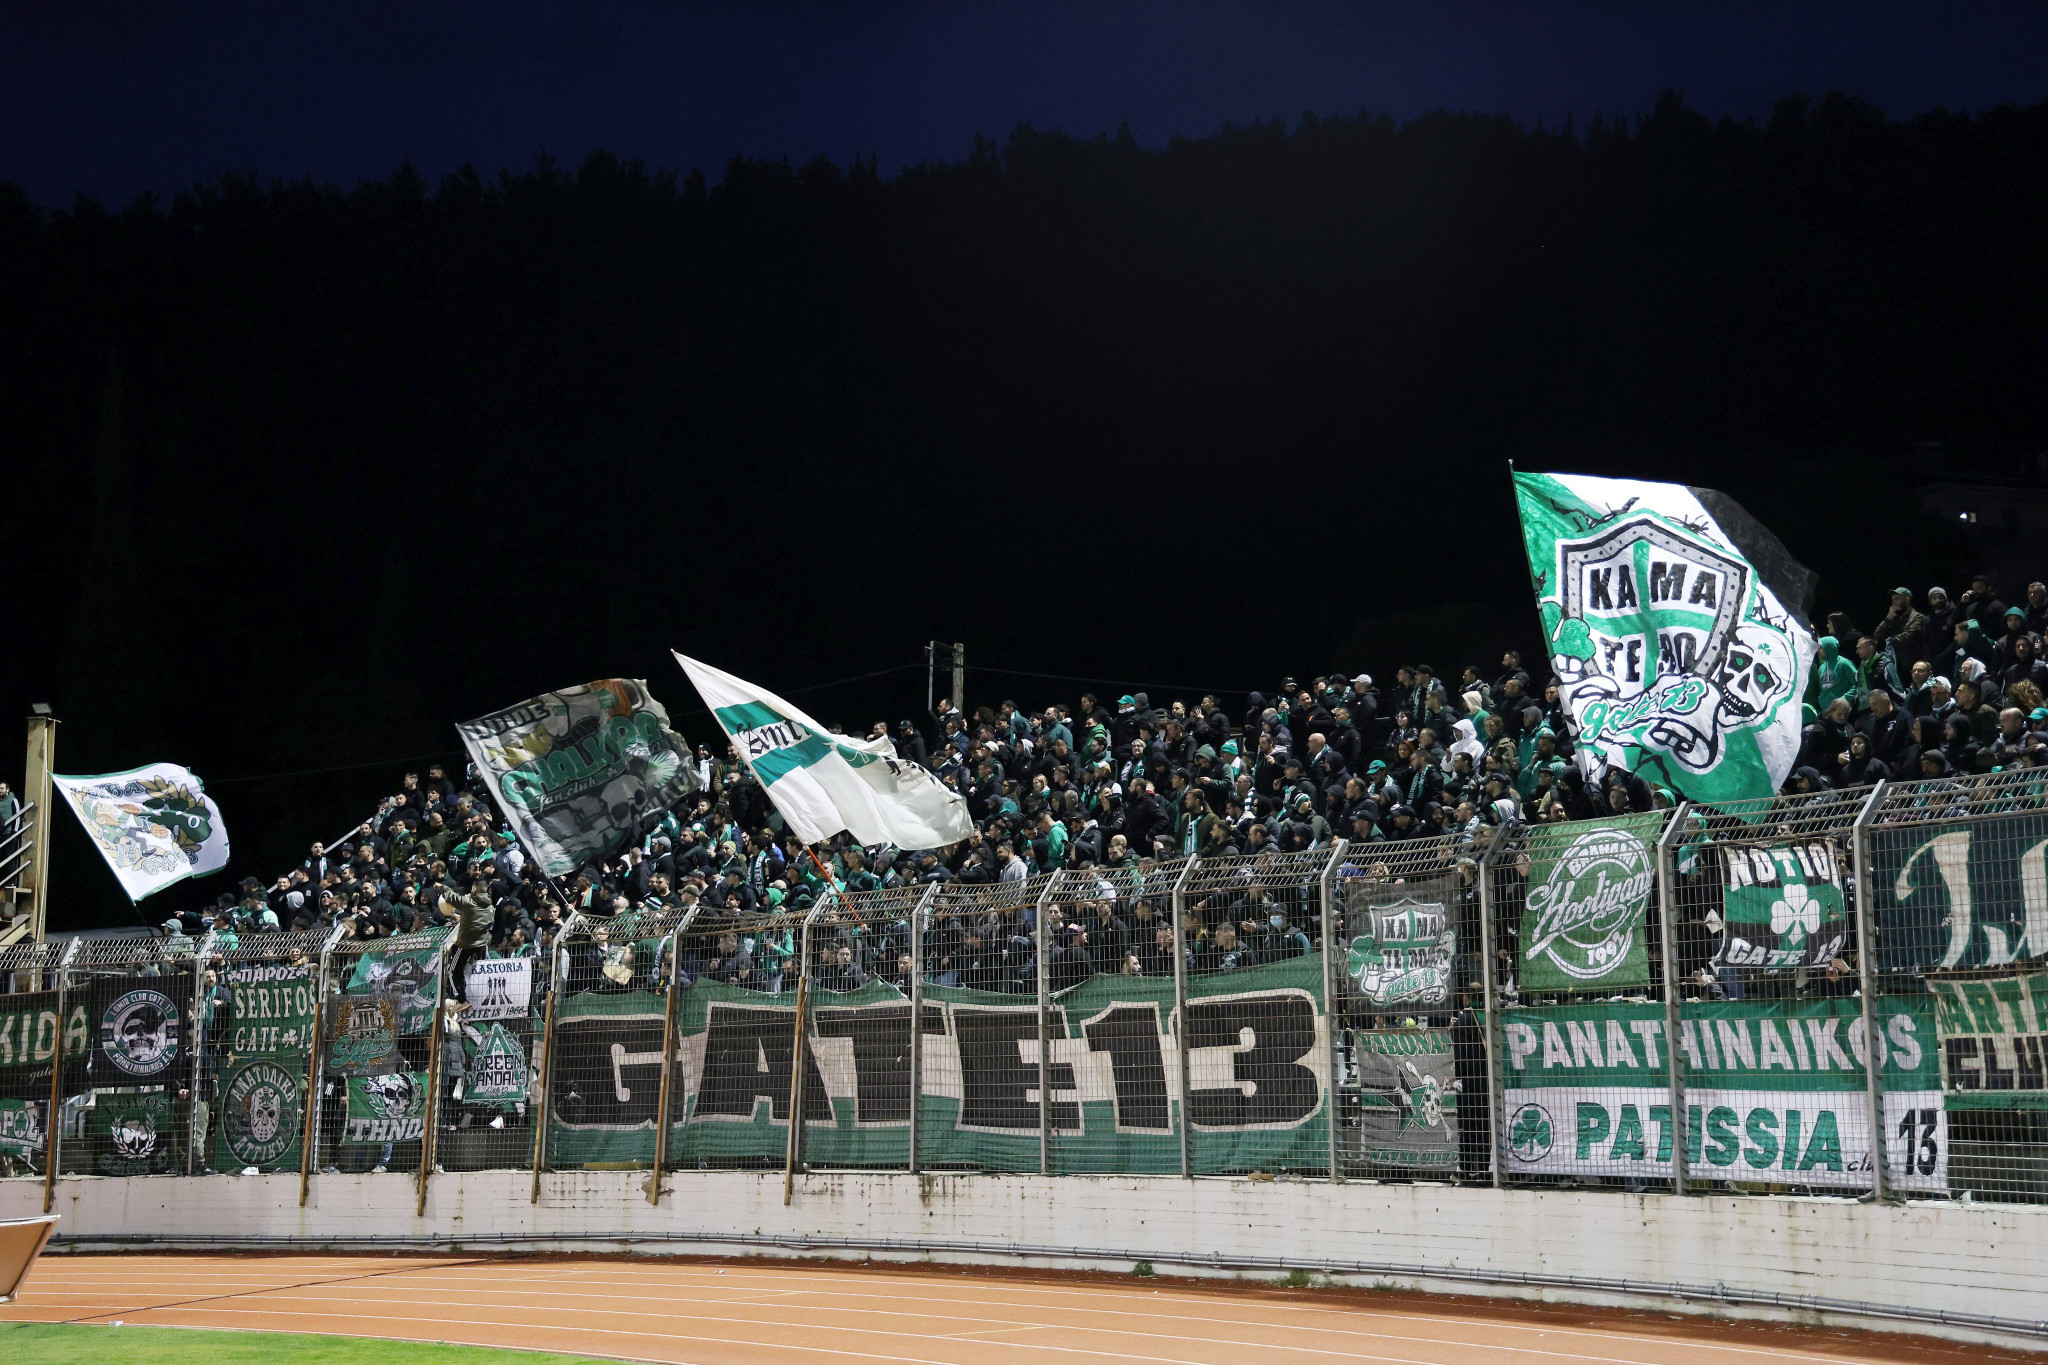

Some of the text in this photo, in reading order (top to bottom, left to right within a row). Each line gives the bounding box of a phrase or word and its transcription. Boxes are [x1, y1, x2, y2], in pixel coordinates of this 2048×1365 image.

[1661, 678, 1708, 716] 13
[1726, 934, 1842, 966] GATE 13
[471, 961, 524, 975] KASTORIA
[149, 993, 165, 1006] GATE
[1385, 967, 1437, 1004] gate 13
[461, 1009, 490, 1019] GATE
[491, 1008, 502, 1018] 13
[235, 1027, 280, 1052] GATE
[1505, 1014, 1922, 1072] PANATHINAIKOS
[552, 988, 1325, 1136] GATE 13
[1576, 1102, 1843, 1173] PATISSIA
[1899, 1108, 1937, 1176] 13
